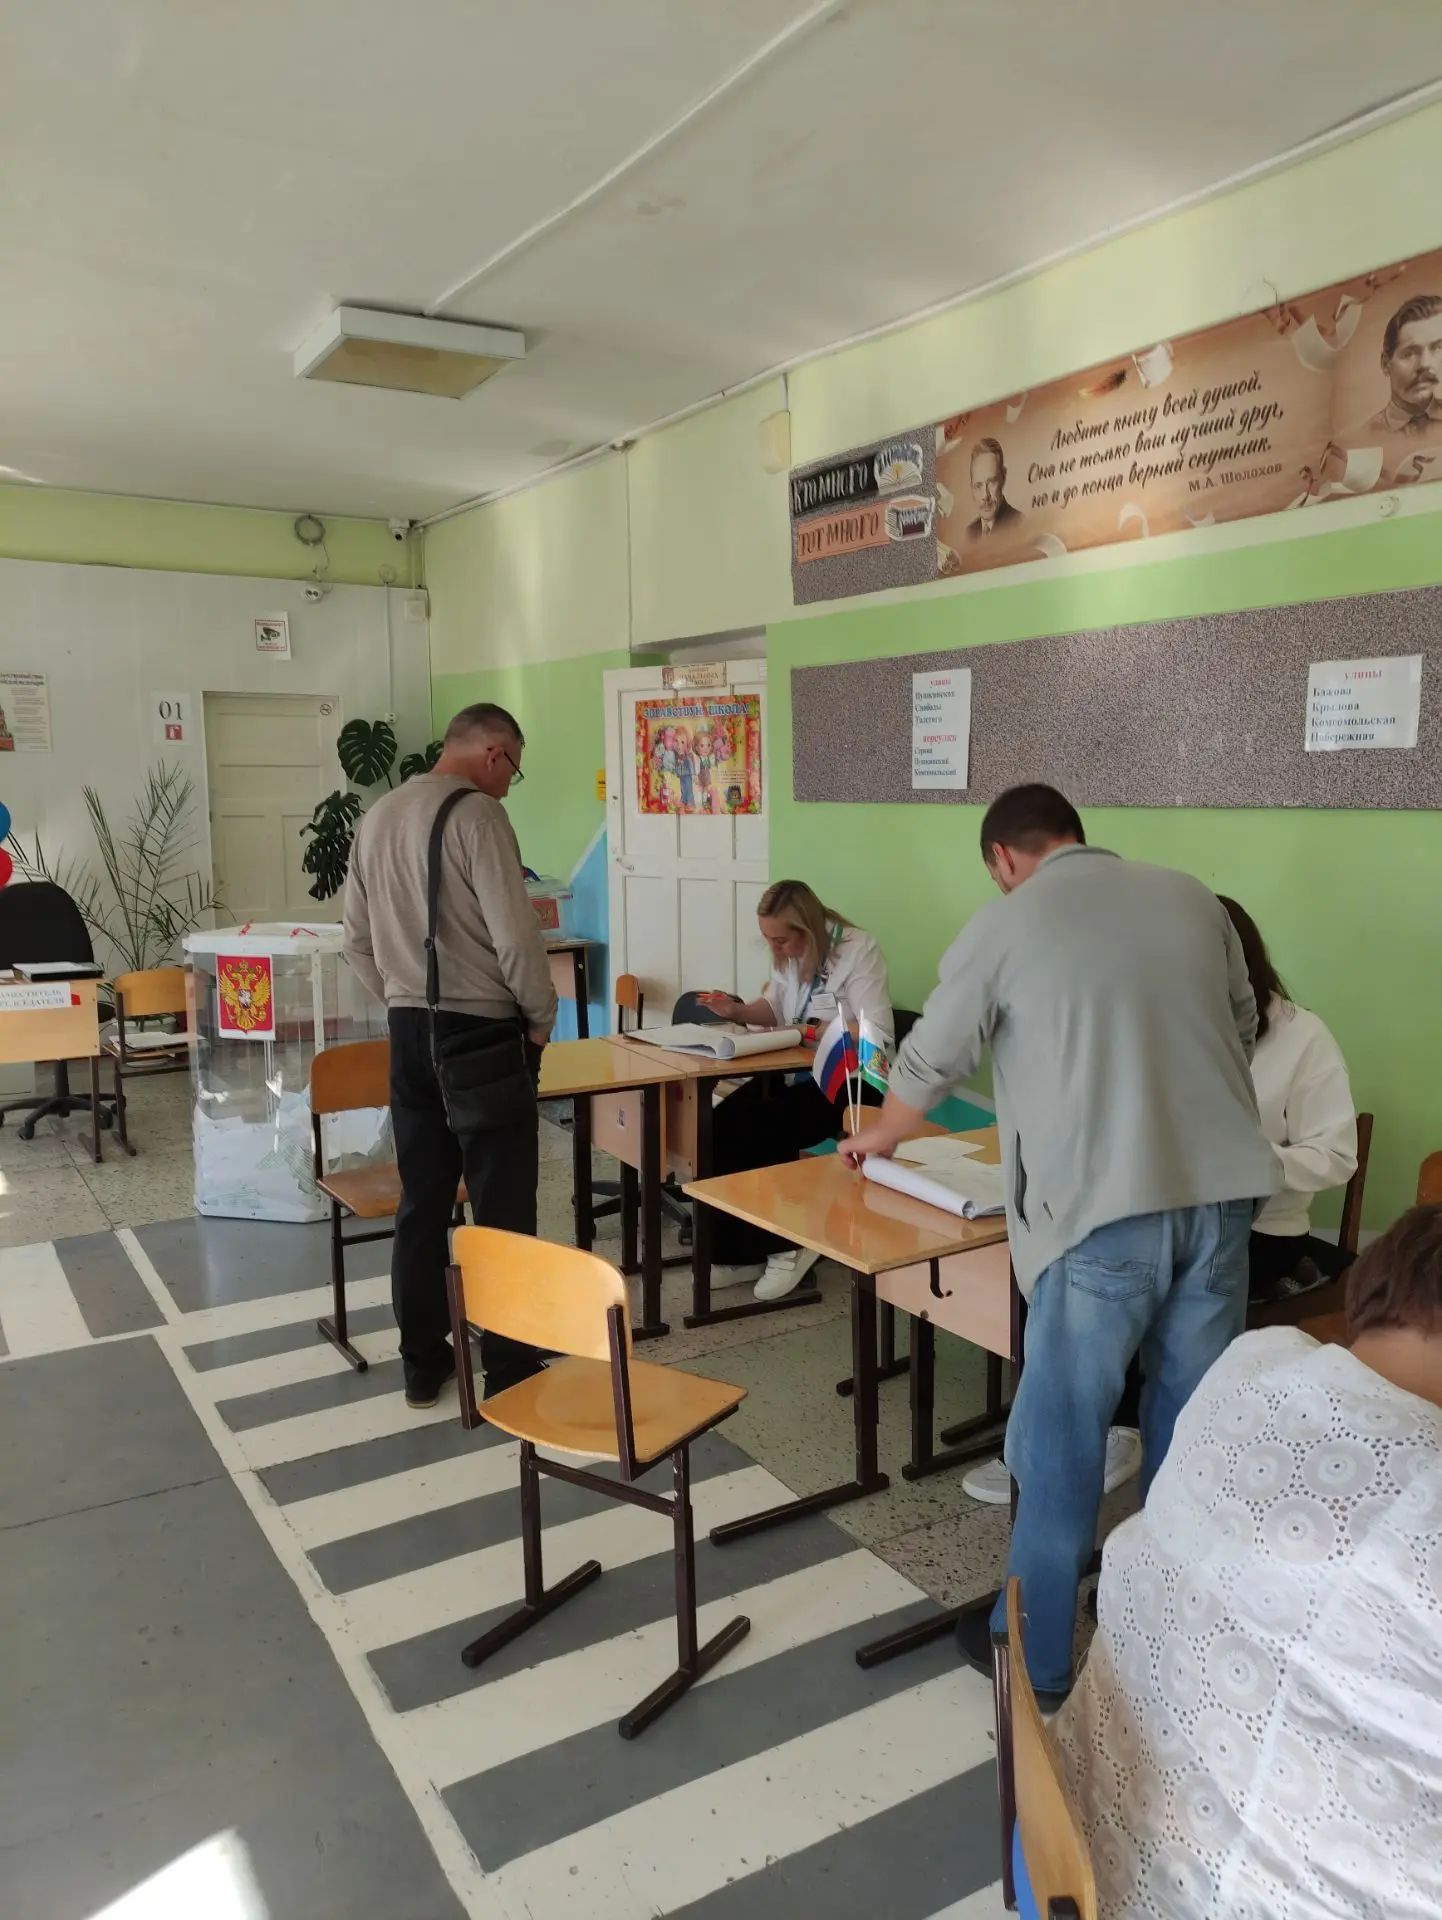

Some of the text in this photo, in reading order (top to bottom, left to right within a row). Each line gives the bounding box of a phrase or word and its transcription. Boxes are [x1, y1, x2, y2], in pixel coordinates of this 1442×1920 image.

[1028, 401, 1285, 485] Она не только ваш лучший друг,
[1050, 369, 1262, 451] Любите книгу всей душой.
[1031, 436, 1272, 509] но и до конца верный спутник.
[1221, 463, 1283, 485] Шолохов
[159, 701, 184, 720] 01
